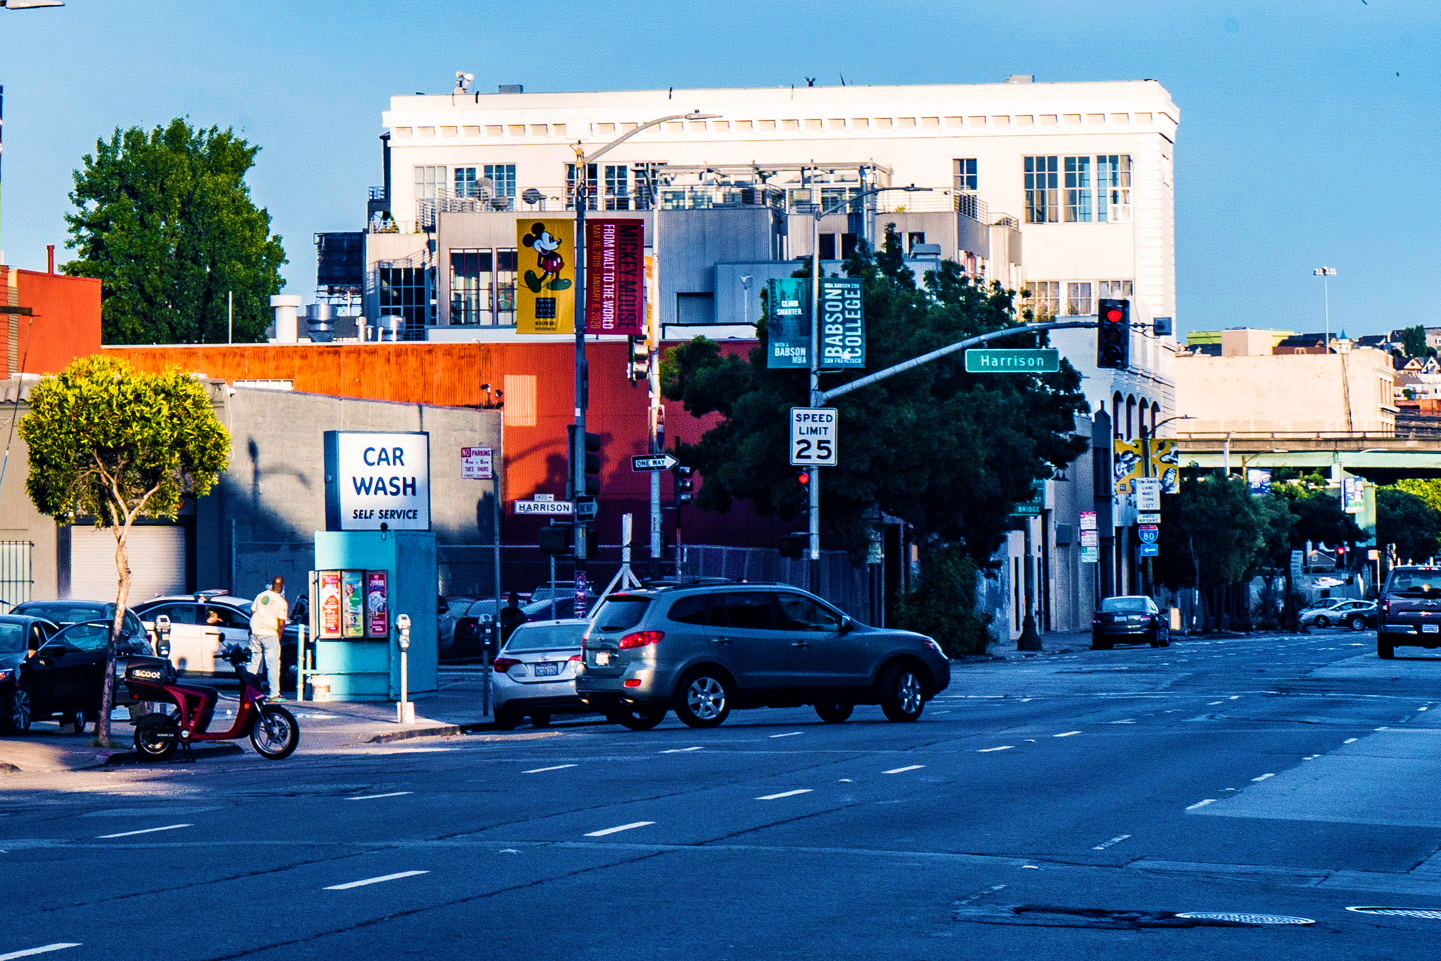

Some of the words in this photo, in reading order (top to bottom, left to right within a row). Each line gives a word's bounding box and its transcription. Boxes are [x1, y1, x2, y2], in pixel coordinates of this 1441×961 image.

[603, 224, 615, 247] FROM
[603, 249, 615, 270] WALT
[618, 225, 639, 277] MICKEY
[603, 272, 614, 282] TO
[603, 283, 614, 299] THE
[617, 280, 638, 329] MOUSE
[602, 300, 614, 330] WORLD
[824, 289, 843, 357] BABSON
[844, 289, 862, 357] COLLEGE
[774, 347, 806, 357] BABSON
[981, 355, 1044, 366] Harrison
[795, 413, 833, 423] SPEED
[799, 426, 829, 435] LIMIT
[363, 447, 405, 467] CAR
[795, 439, 832, 460] 25
[351, 476, 417, 496] WASH
[352, 509, 375, 519] SELF
[378, 509, 418, 520] SERVICE
[519, 504, 570, 512] HARRISON
